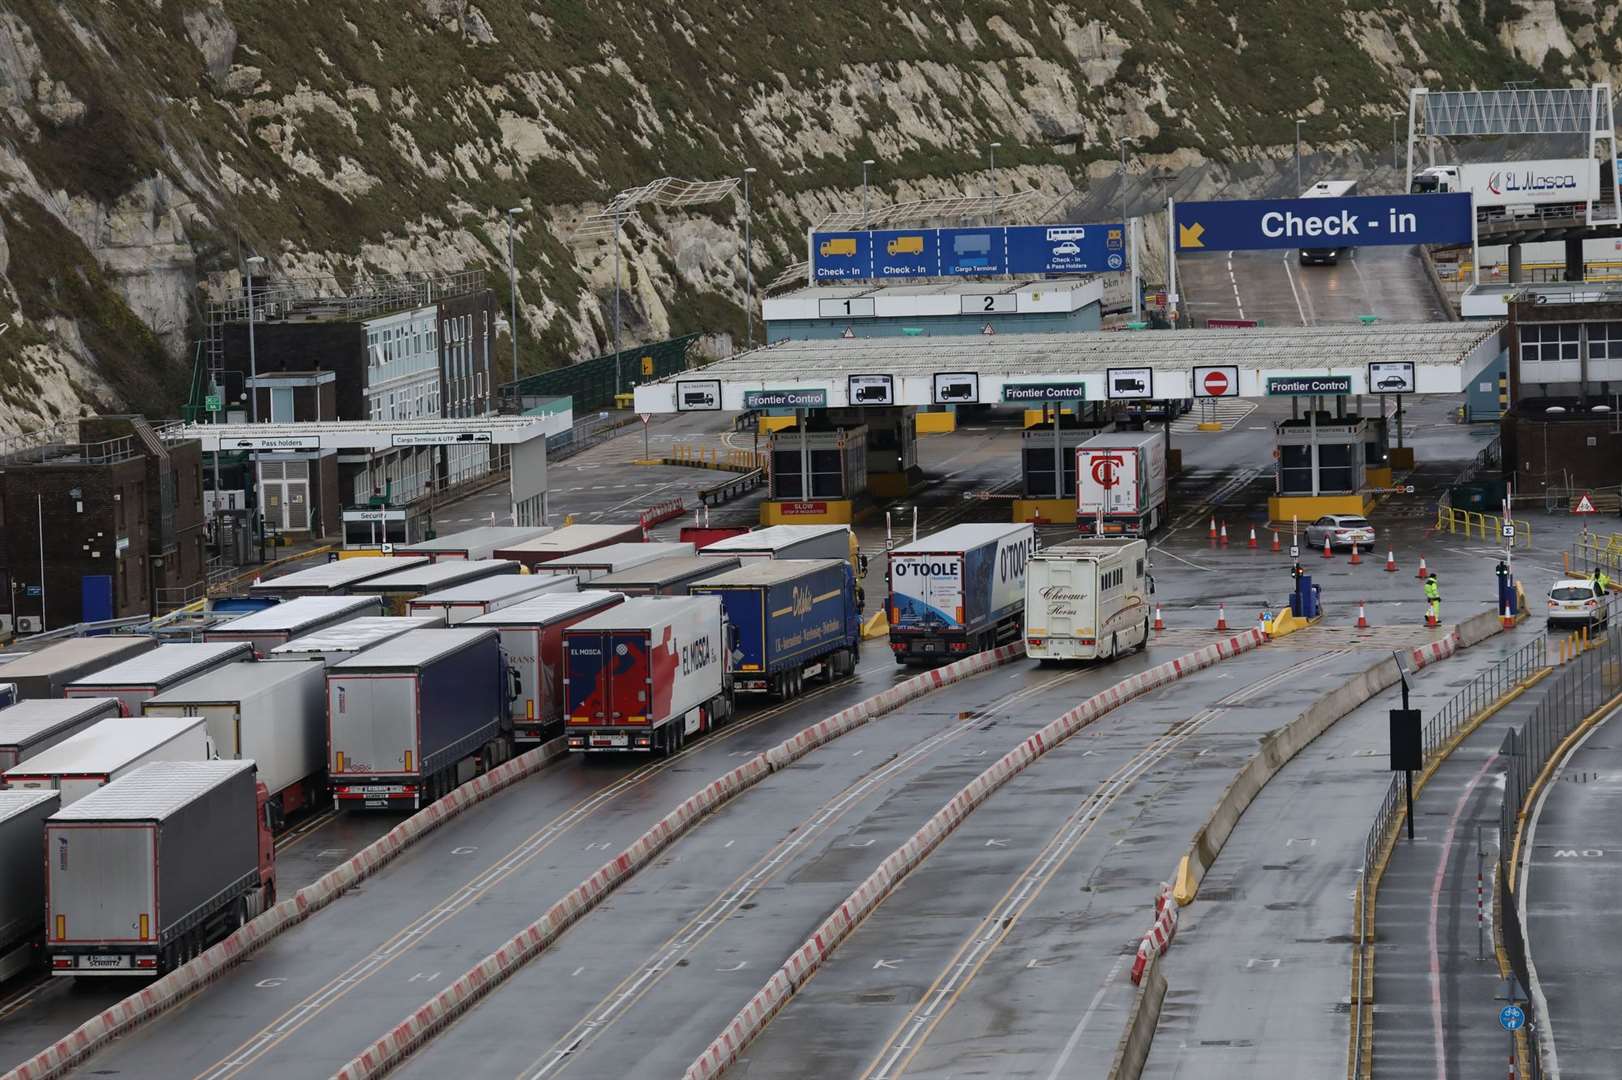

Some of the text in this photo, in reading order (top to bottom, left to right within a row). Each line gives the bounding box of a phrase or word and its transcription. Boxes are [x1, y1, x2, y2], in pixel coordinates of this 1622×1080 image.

[1261, 210, 1359, 238] Check
[1389, 208, 1416, 233] in
[817, 267, 845, 276] Check
[852, 267, 861, 275] In
[883, 265, 910, 275] Check
[917, 265, 926, 273] In
[843, 299, 850, 315] 1
[983, 296, 994, 311] 2
[1006, 387, 1082, 398] Frontier Control
[1271, 381, 1348, 392] Frontier Control
[748, 393, 823, 406] Frontier Control
[360, 512, 387, 520] Securiy
[895, 562, 958, 577] O'TOOLE
[571, 648, 578, 656] EL
[691, 635, 710, 673] MOSCA
